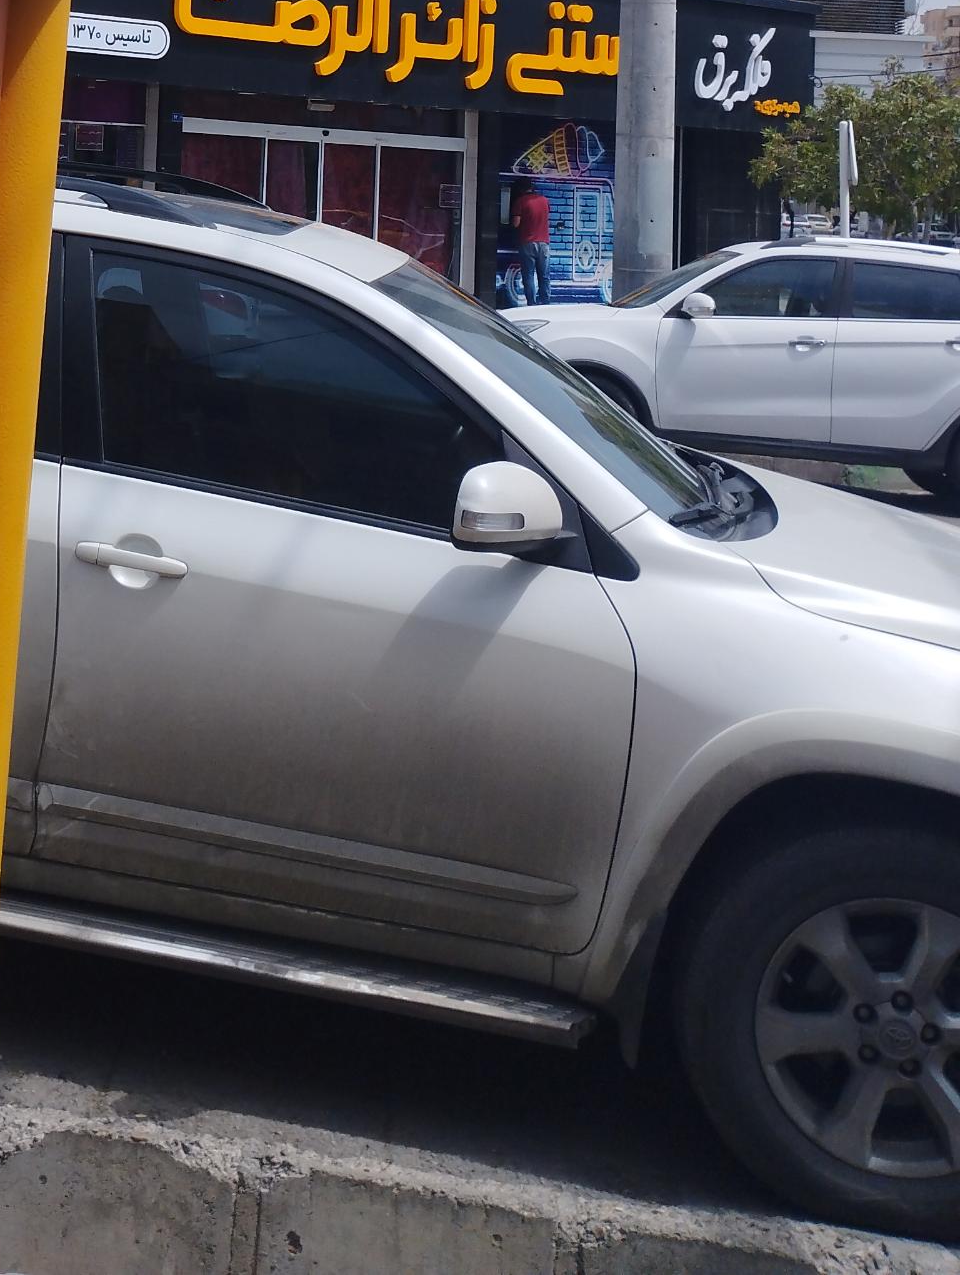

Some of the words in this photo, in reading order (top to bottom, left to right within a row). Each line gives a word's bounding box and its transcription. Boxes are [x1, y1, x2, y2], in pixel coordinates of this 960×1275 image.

[72, 23, 102, 40] ۱۳۷۰
[105, 28, 152, 47] تاسیس
[505, 1, 620, 96] ستنی
[694, 34, 739, 112] برق
